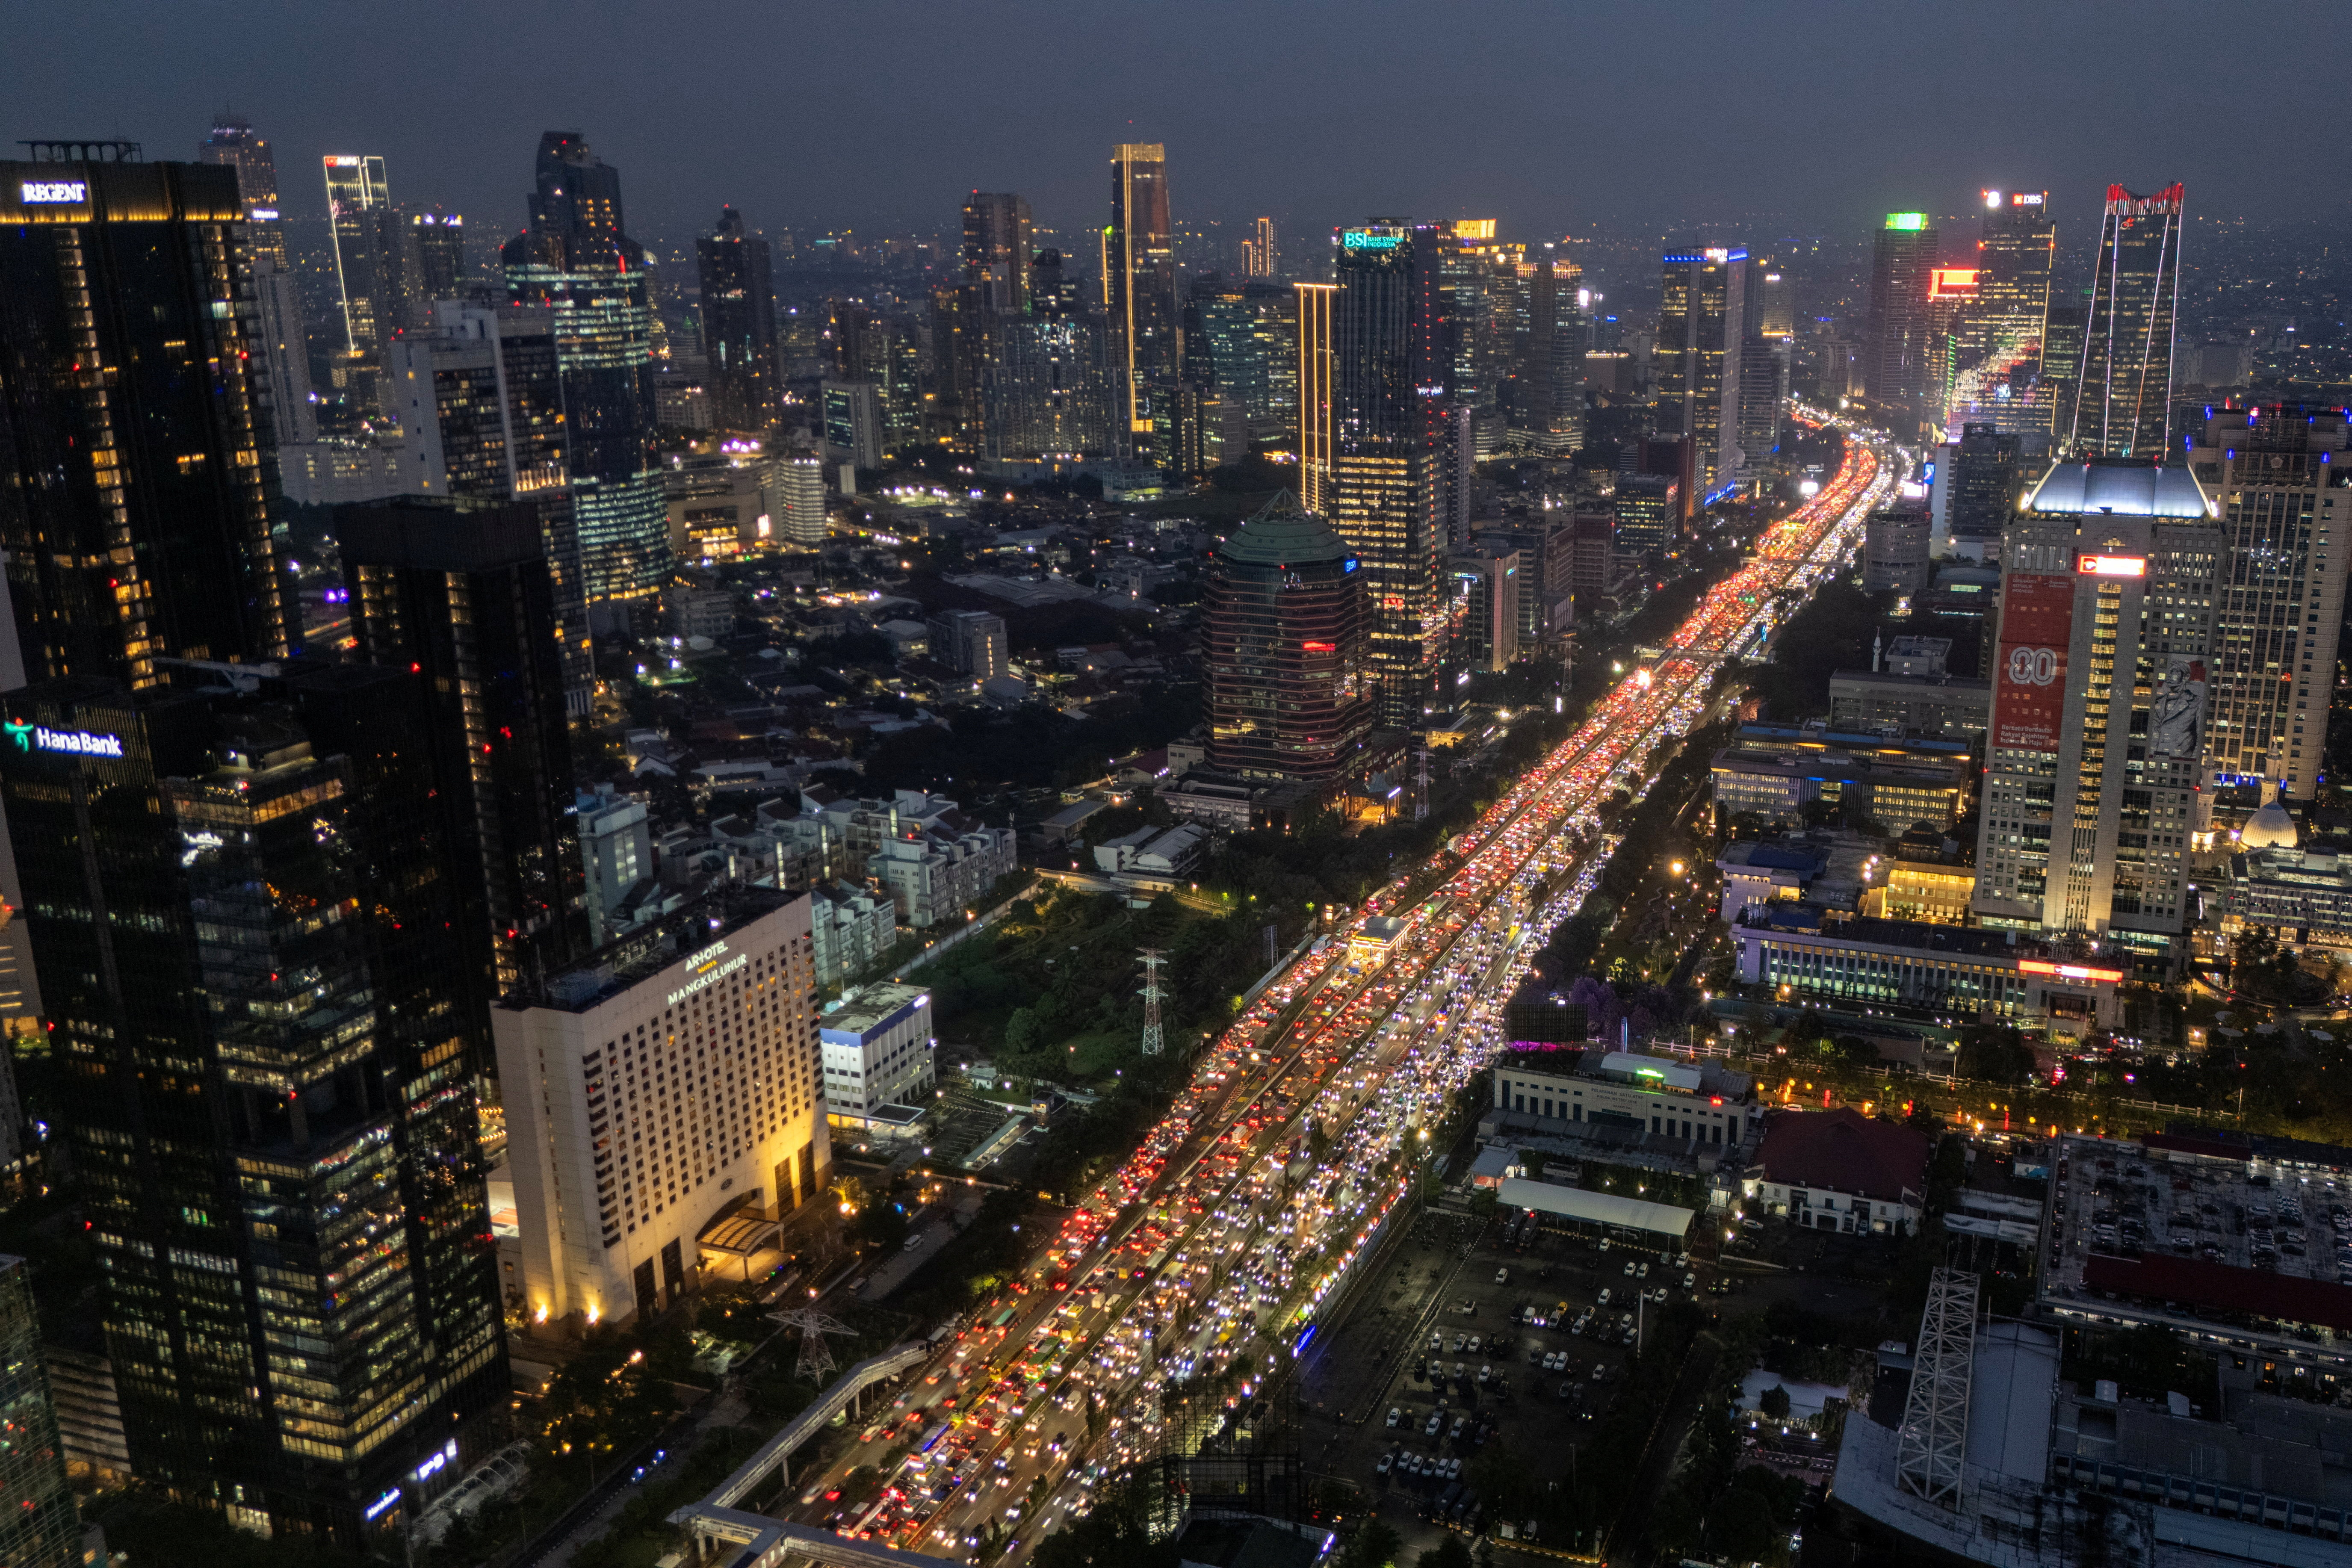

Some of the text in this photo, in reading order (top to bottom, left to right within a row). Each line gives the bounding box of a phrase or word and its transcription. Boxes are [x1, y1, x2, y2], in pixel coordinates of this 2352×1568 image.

[22, 183, 85, 201] REGENT
[2023, 195, 2042, 204] DBS
[1345, 232, 1367, 247] BSI
[2009, 646, 2057, 686] 80
[668, 953, 747, 1005] MANGKULUHUR
[1591, 1087, 1617, 1096] PELAYANAN
